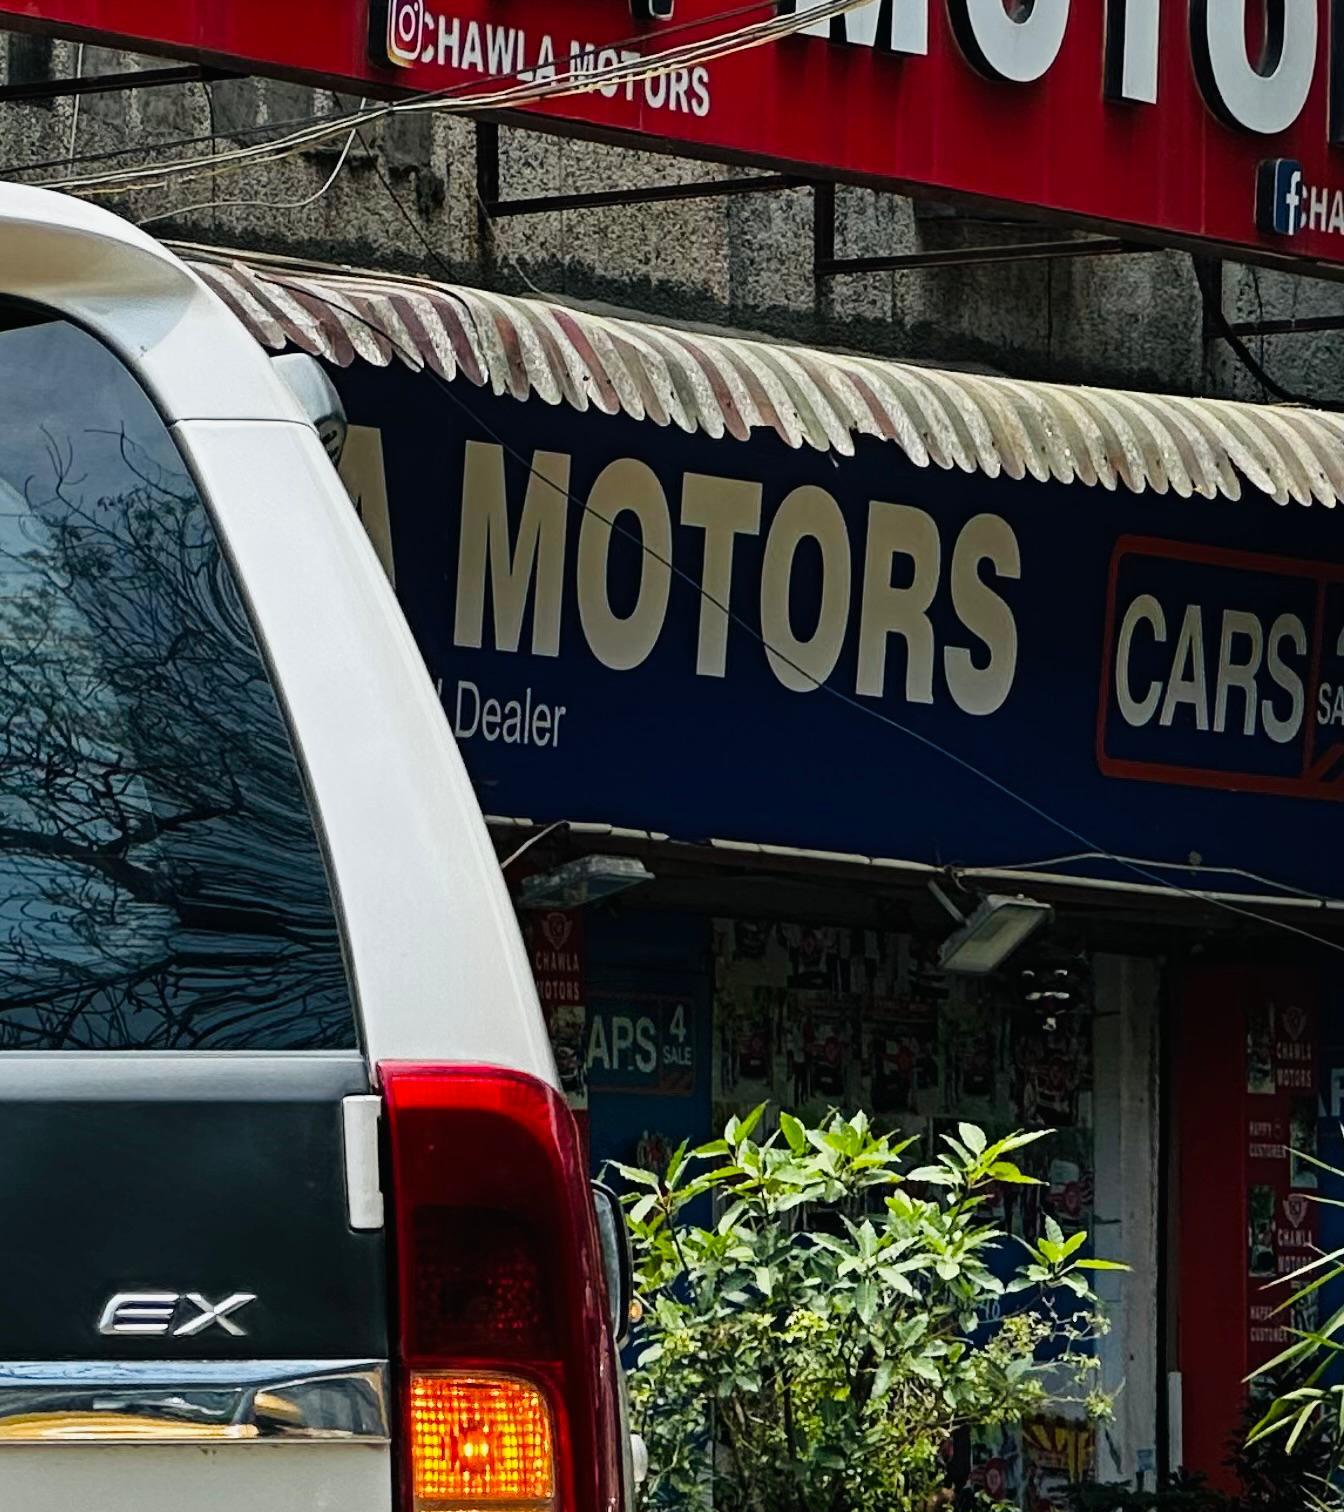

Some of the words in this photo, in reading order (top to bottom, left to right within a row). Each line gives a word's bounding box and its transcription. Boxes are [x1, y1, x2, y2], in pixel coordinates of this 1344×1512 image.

[454, 440, 1022, 717] MOTORS
[1116, 594, 1307, 743] CARS
[455, 680, 566, 748] Dealer
[535, 951, 580, 972] CHAWLA
[663, 1045, 693, 1066] SALE
[99, 1292, 258, 1337] EX
